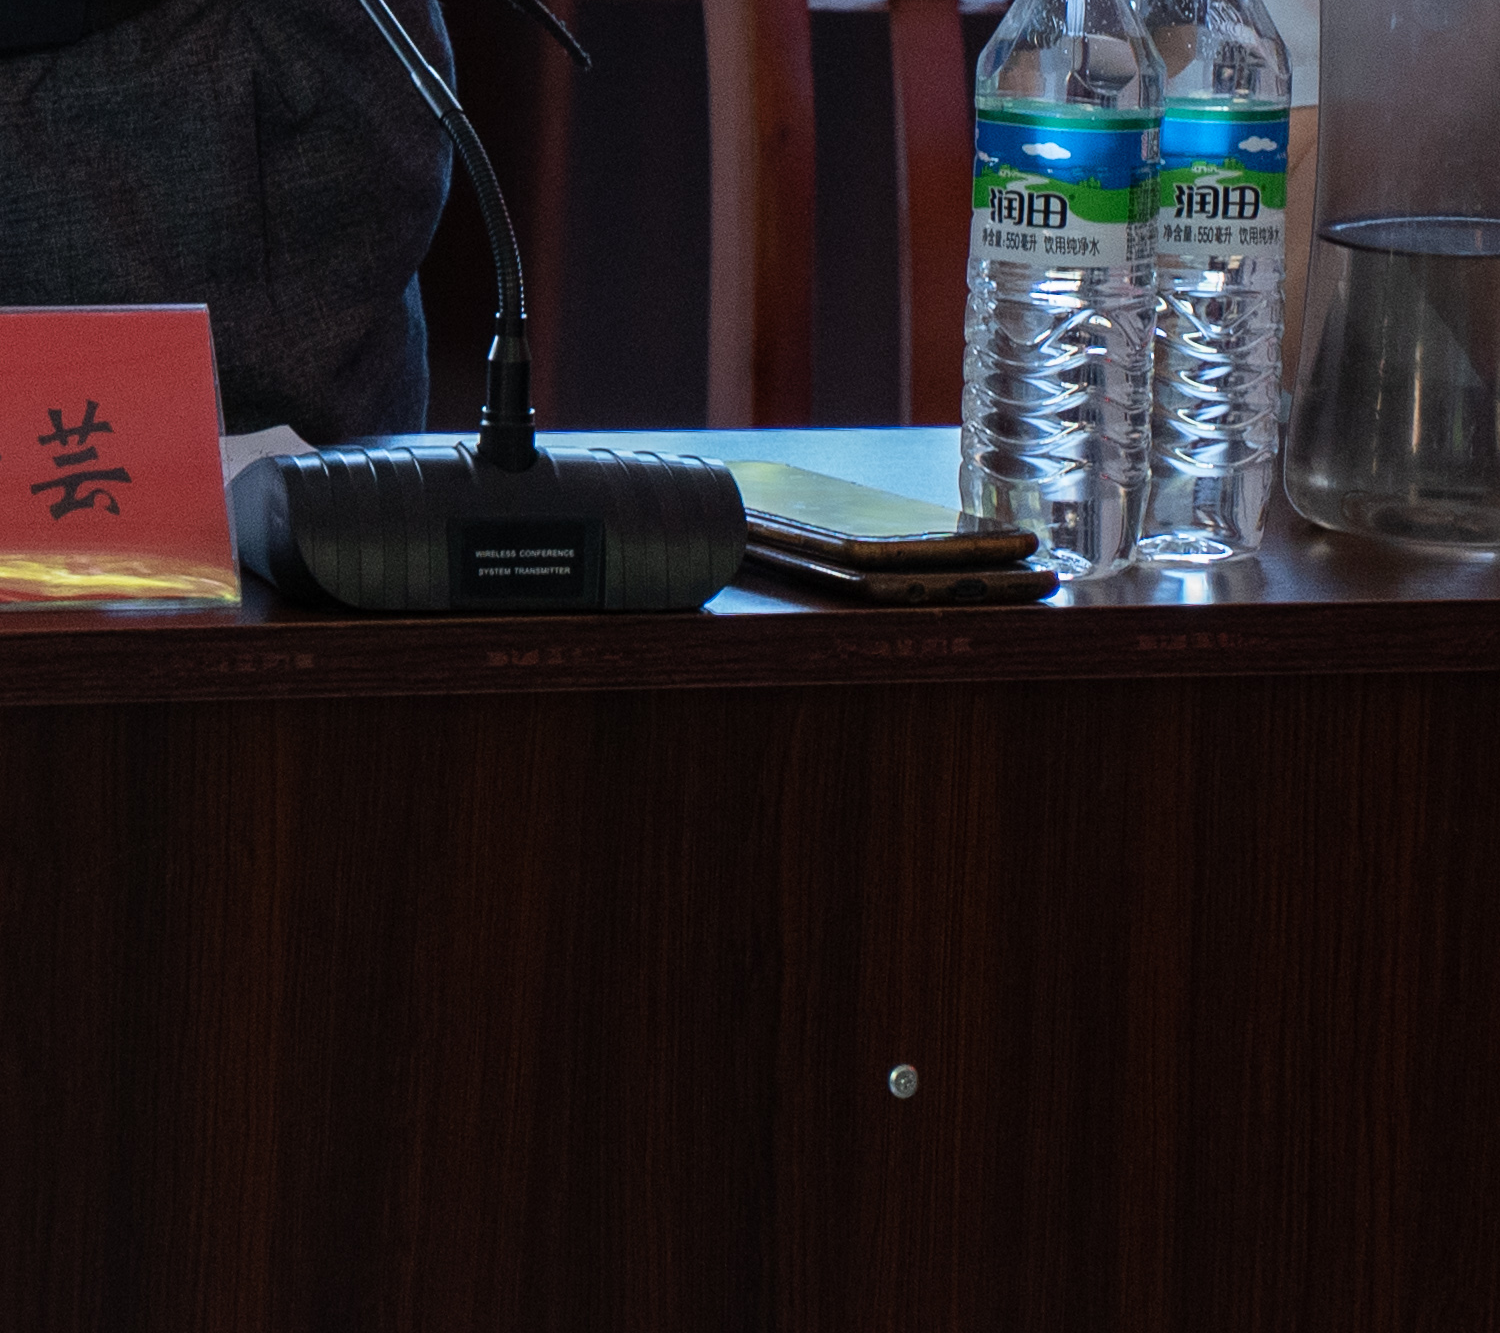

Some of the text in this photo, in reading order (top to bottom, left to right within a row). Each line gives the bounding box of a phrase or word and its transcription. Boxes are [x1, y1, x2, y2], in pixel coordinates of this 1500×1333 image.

[990, 187, 1068, 229] 润田
[1174, 184, 1261, 220] 润田
[1043, 236, 1100, 256] 饮用纯净水
[475, 548, 575, 559] WIRELESS CONFERENCE
[478, 566, 571, 577] SYSTEM TRANSMITTER
